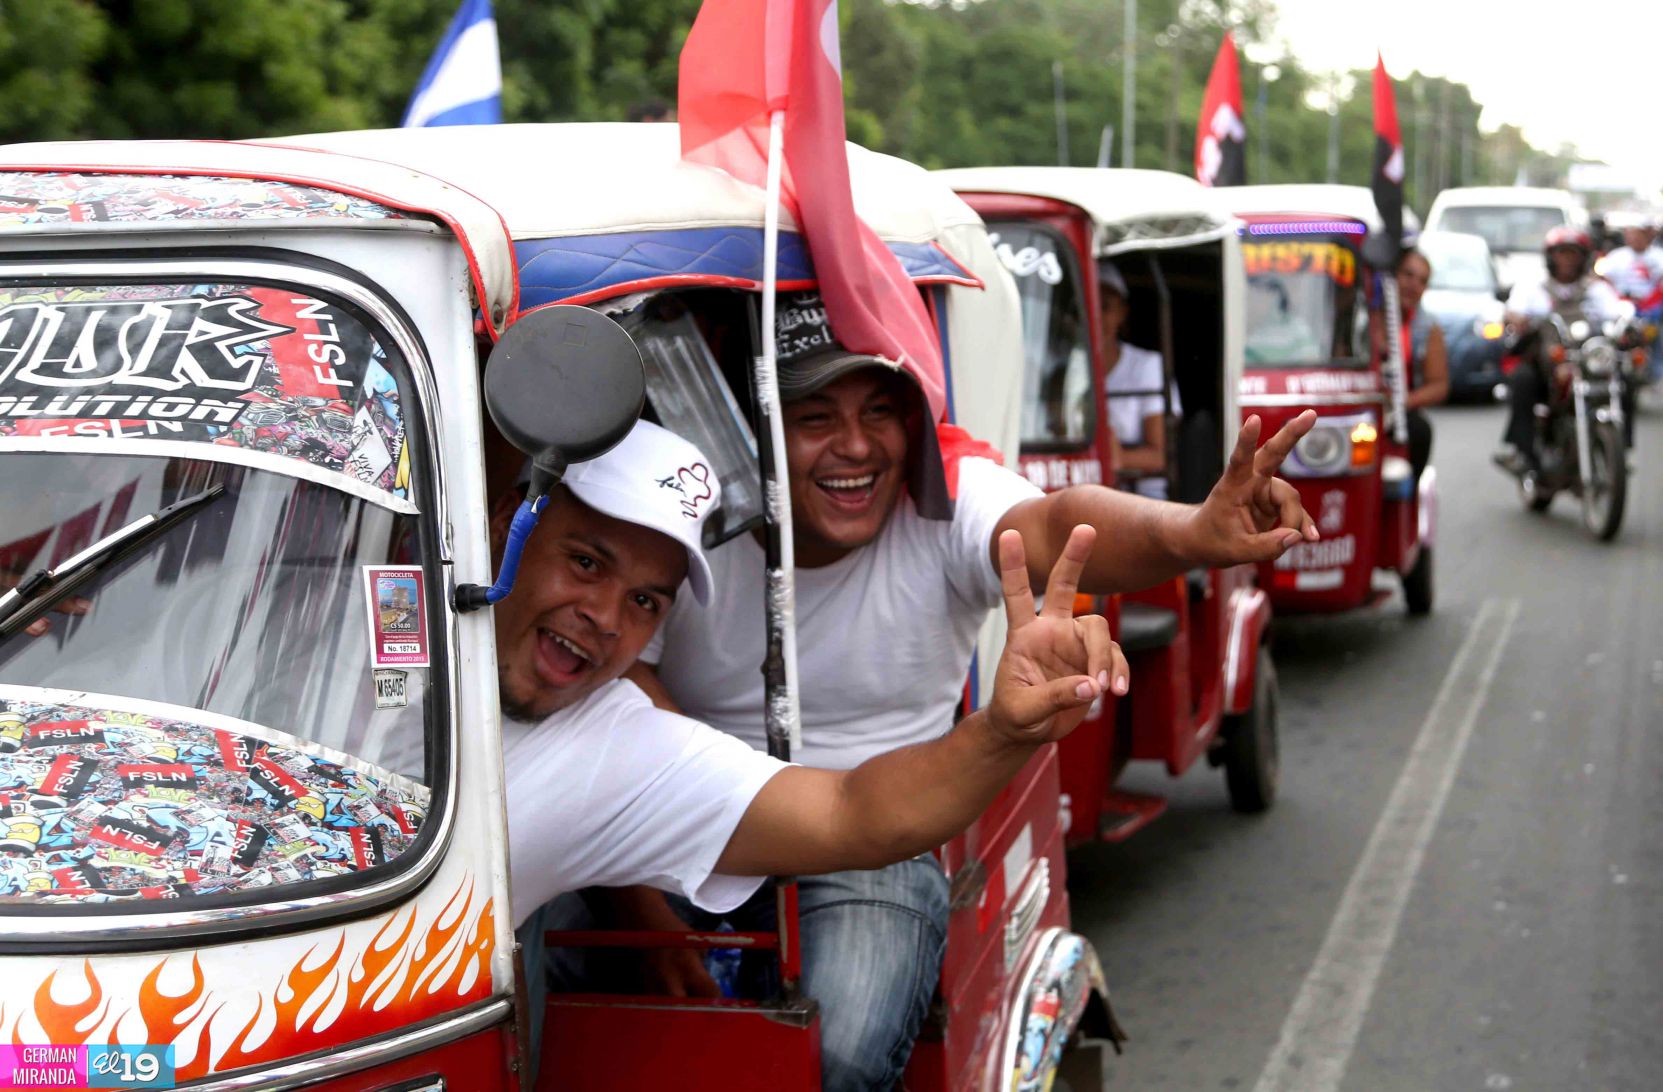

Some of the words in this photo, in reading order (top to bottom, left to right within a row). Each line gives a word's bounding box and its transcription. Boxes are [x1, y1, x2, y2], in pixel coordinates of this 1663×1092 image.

[291, 298, 353, 388] FSLN
[38, 727, 95, 740] FSLN
[229, 733, 254, 768] FSLN
[53, 760, 84, 793] FSLN
[128, 771, 187, 782] FSLN
[251, 762, 296, 796] FSLN
[102, 824, 160, 850] FSLN
[231, 824, 257, 859] FSLN
[359, 833, 377, 867] FSLN
